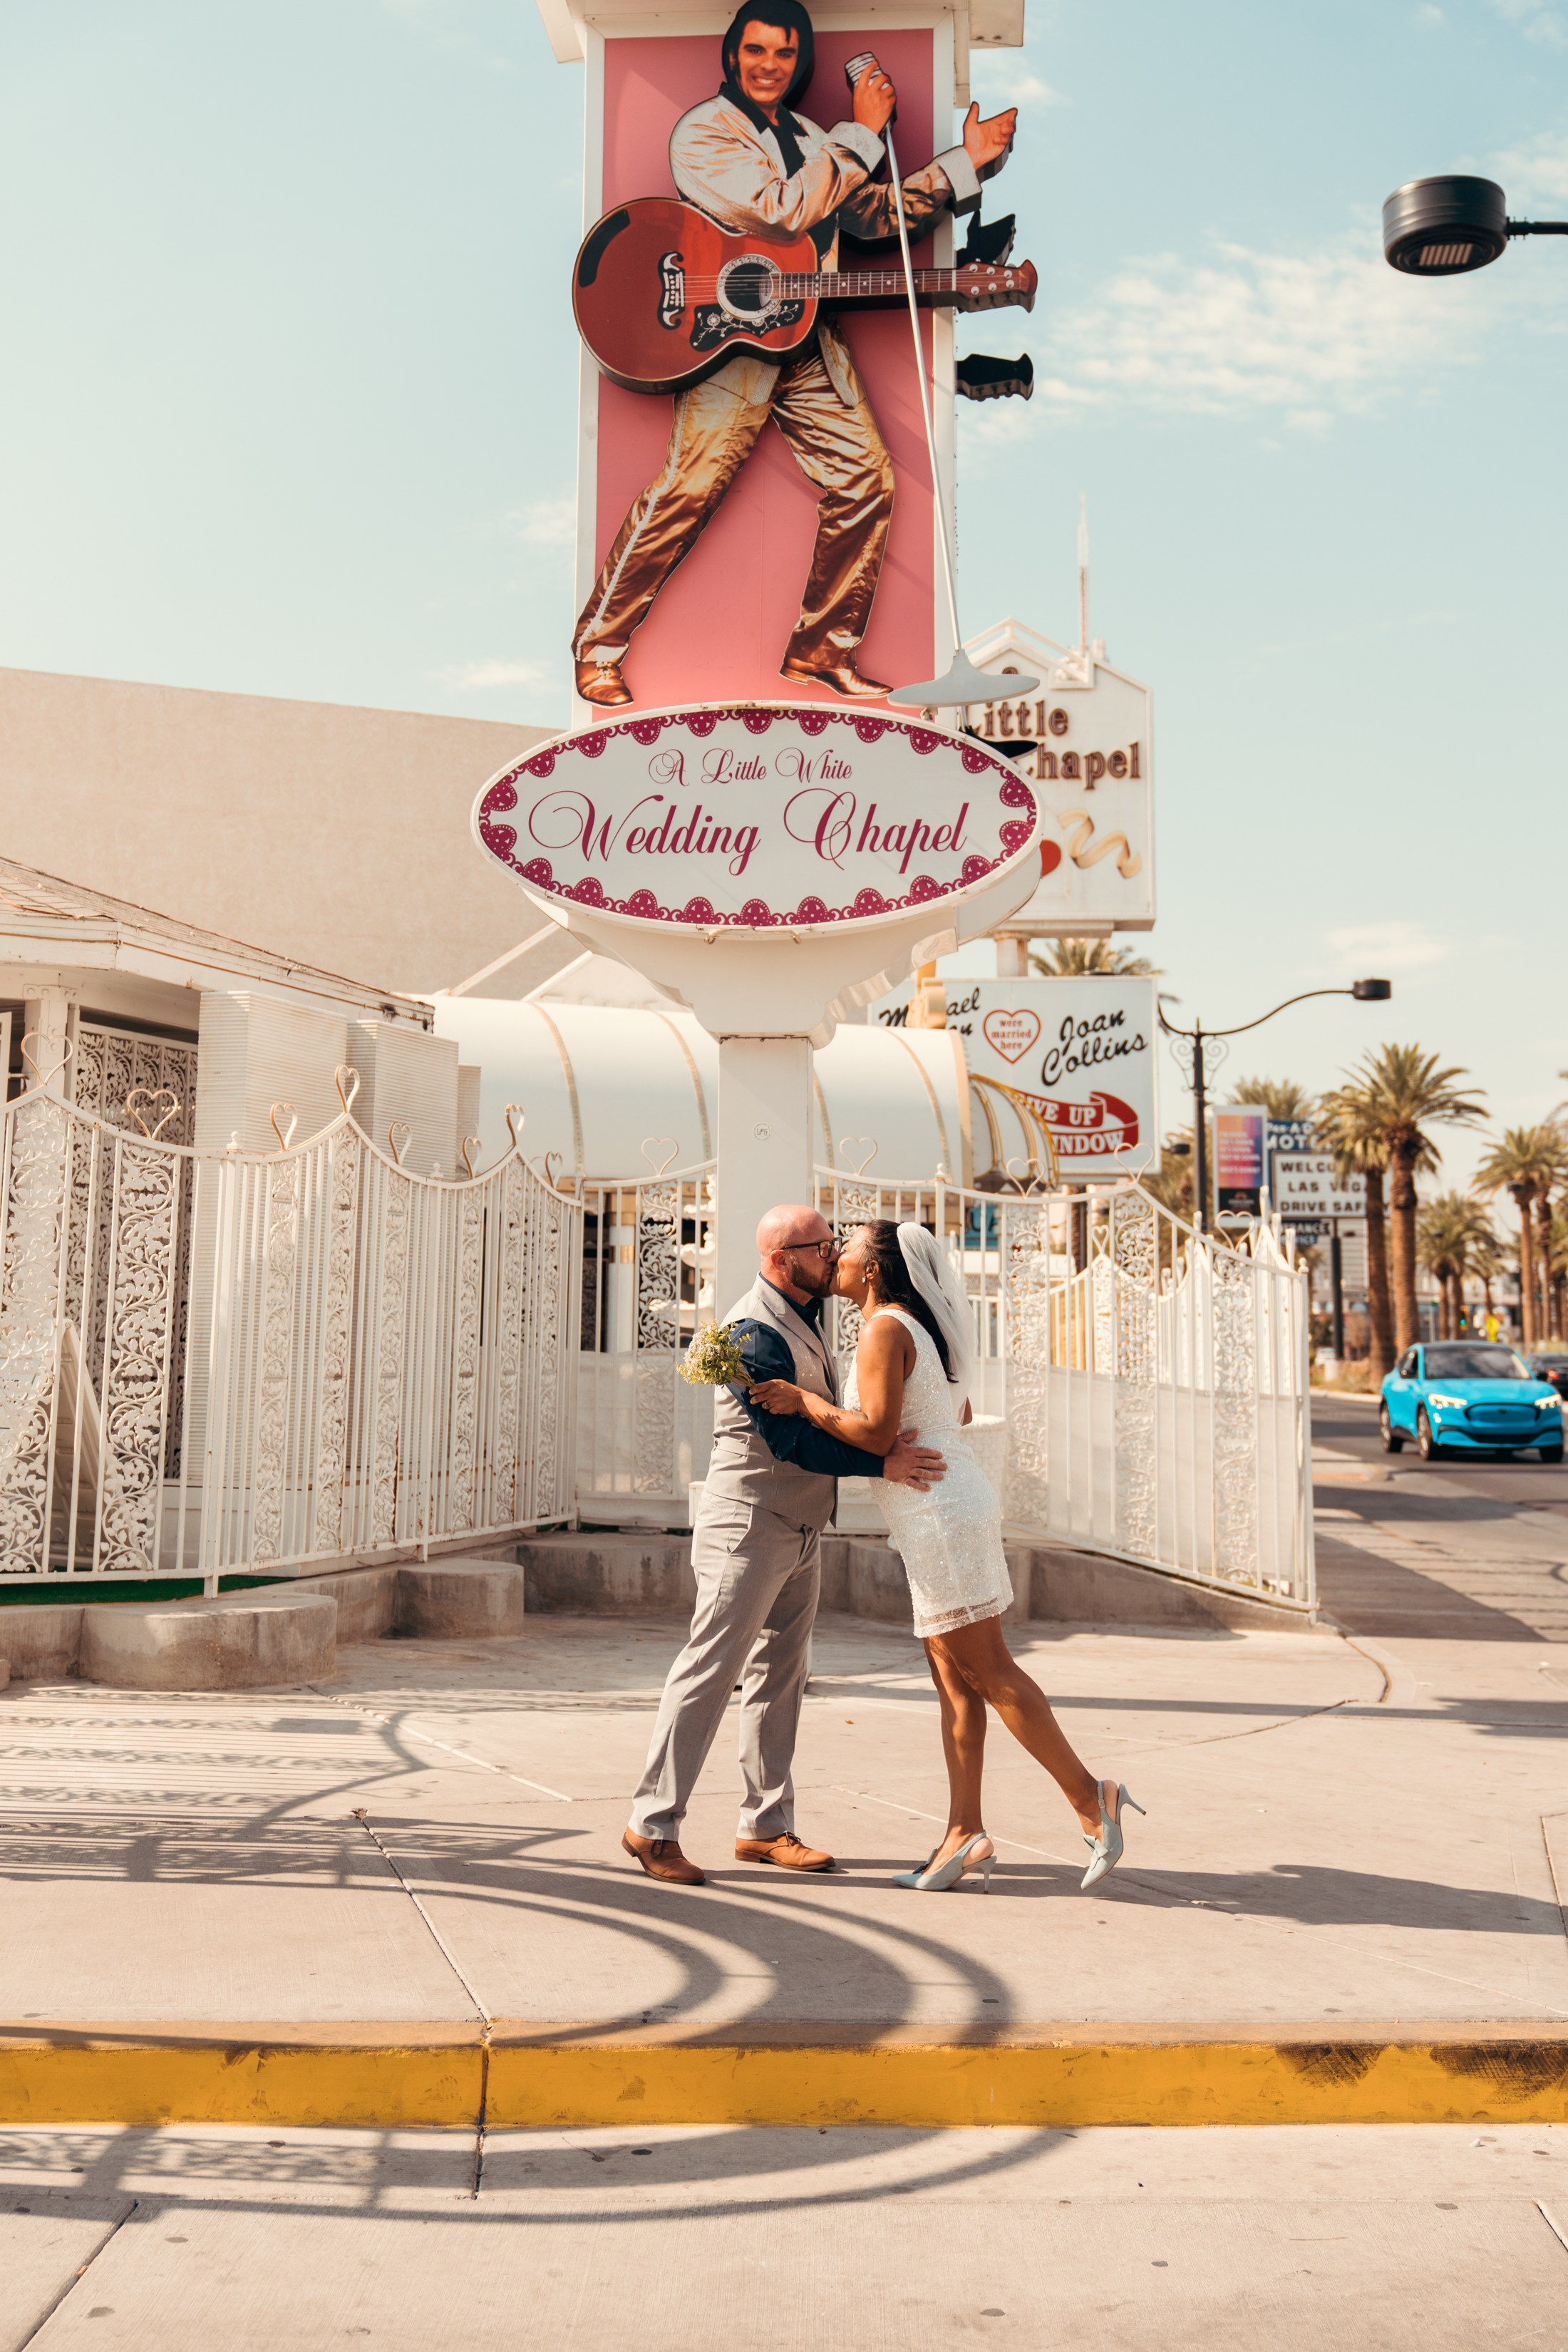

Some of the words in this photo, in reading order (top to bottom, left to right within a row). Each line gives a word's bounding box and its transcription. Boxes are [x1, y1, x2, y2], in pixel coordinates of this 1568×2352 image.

[649, 749, 689, 787] A
[701, 748, 767, 784] Little
[775, 747, 852, 783] White
[1026, 741, 1141, 790] hapel
[528, 790, 761, 876] Wedding
[783, 788, 967, 874] Chapel
[991, 1028, 1031, 1038] married
[1000, 1040, 1023, 1050] here
[1060, 1009, 1125, 1056] Joan
[1041, 1032, 1148, 1087] Collins
[1068, 1105, 1097, 1125] UP
[1051, 1130, 1125, 1155] INDOW
[1289, 1182, 1320, 1192] LAS
[1330, 1182, 1363, 1192] VEG
[1280, 1202, 1326, 1212] DRIVE
[1332, 1202, 1389, 1212] SAFY
